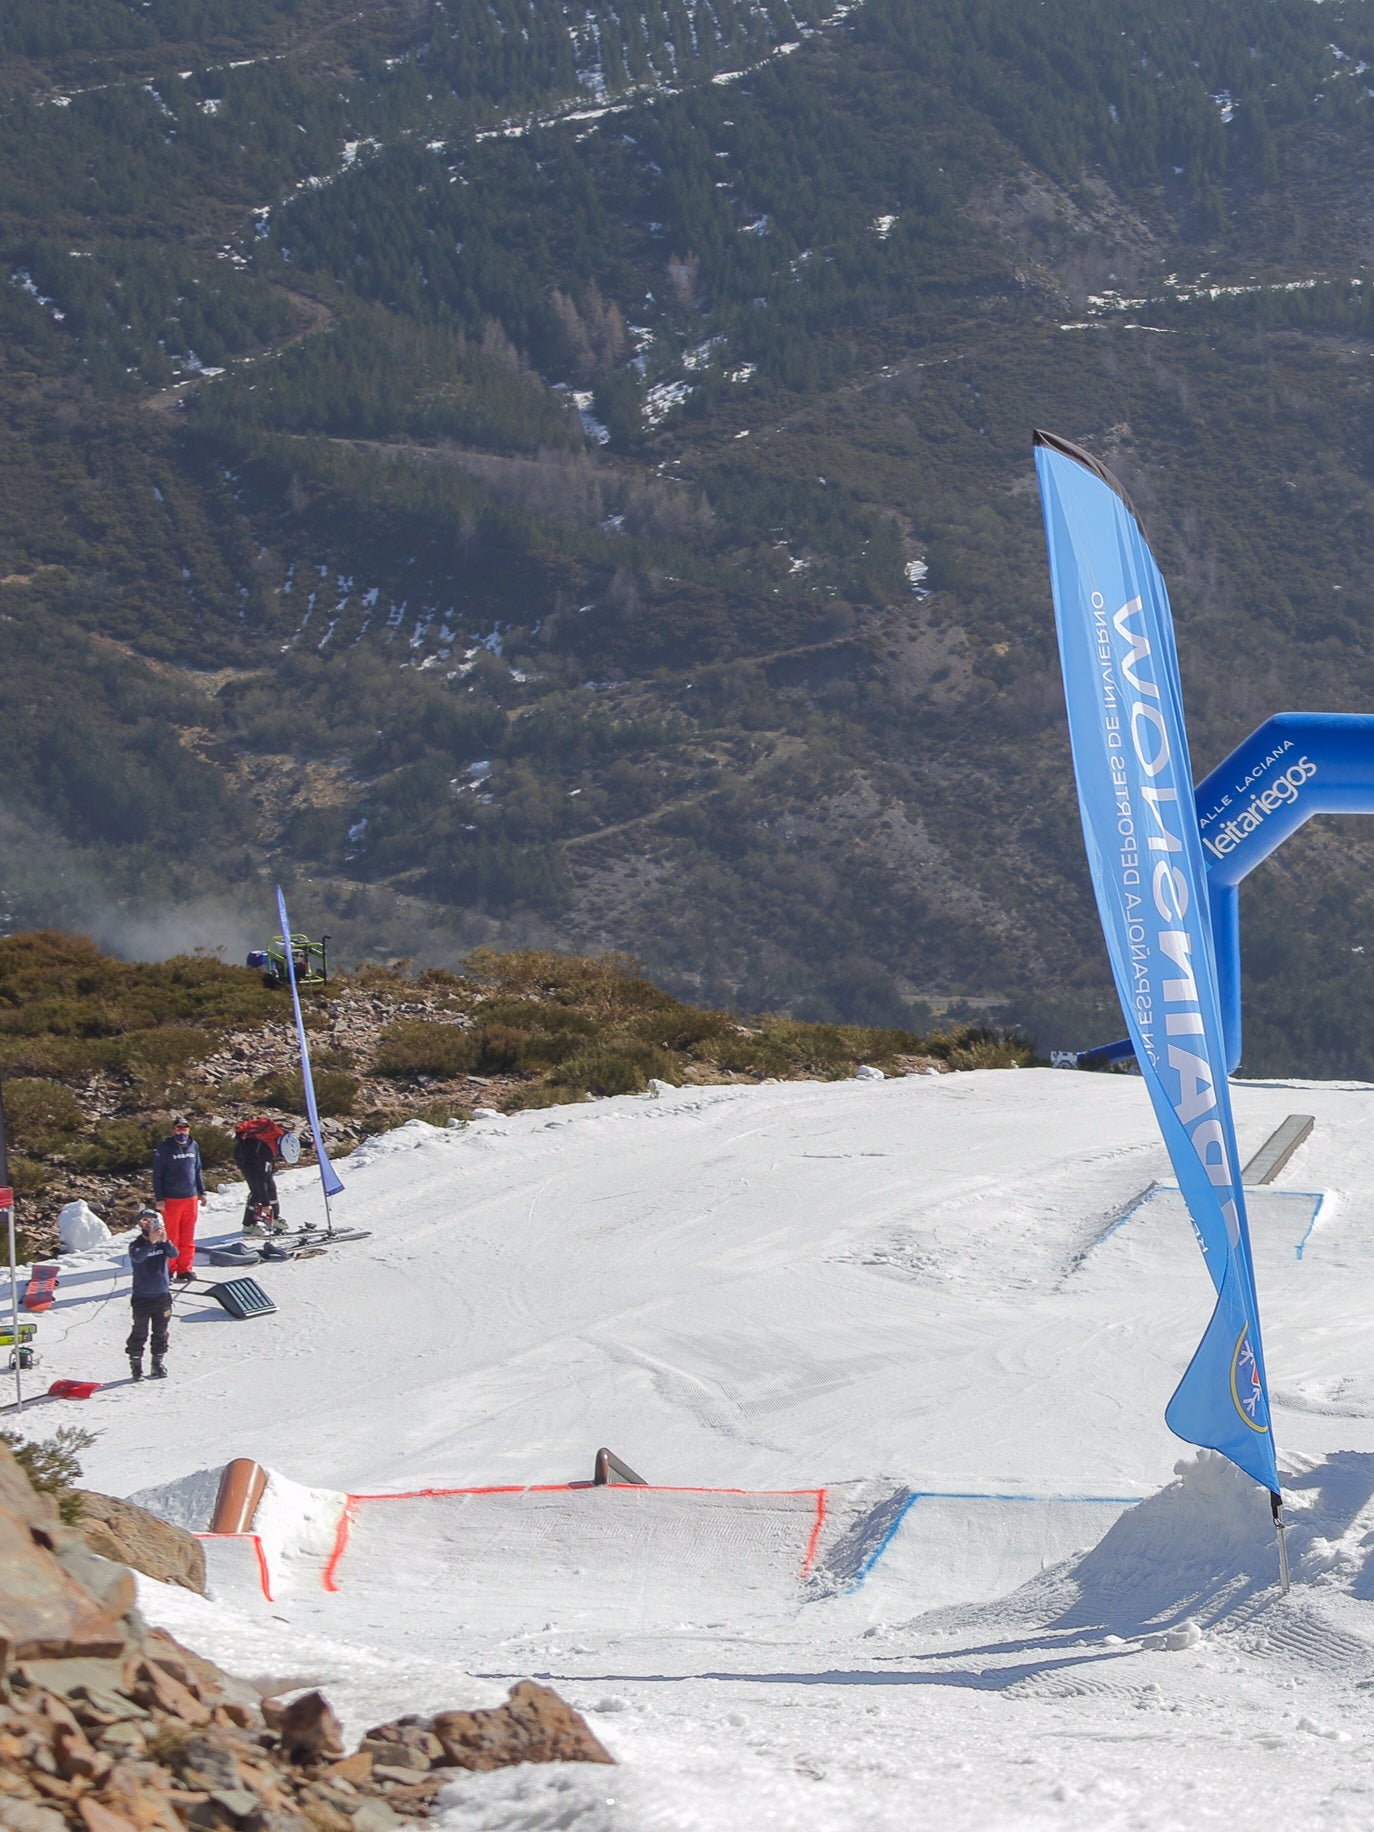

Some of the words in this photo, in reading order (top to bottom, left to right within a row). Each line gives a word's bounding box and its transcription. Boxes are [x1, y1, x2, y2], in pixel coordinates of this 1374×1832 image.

[1199, 796, 1233, 829] ALLE
[1235, 739, 1295, 795] LACIANA
[1201, 755, 1318, 860] leitariegos
